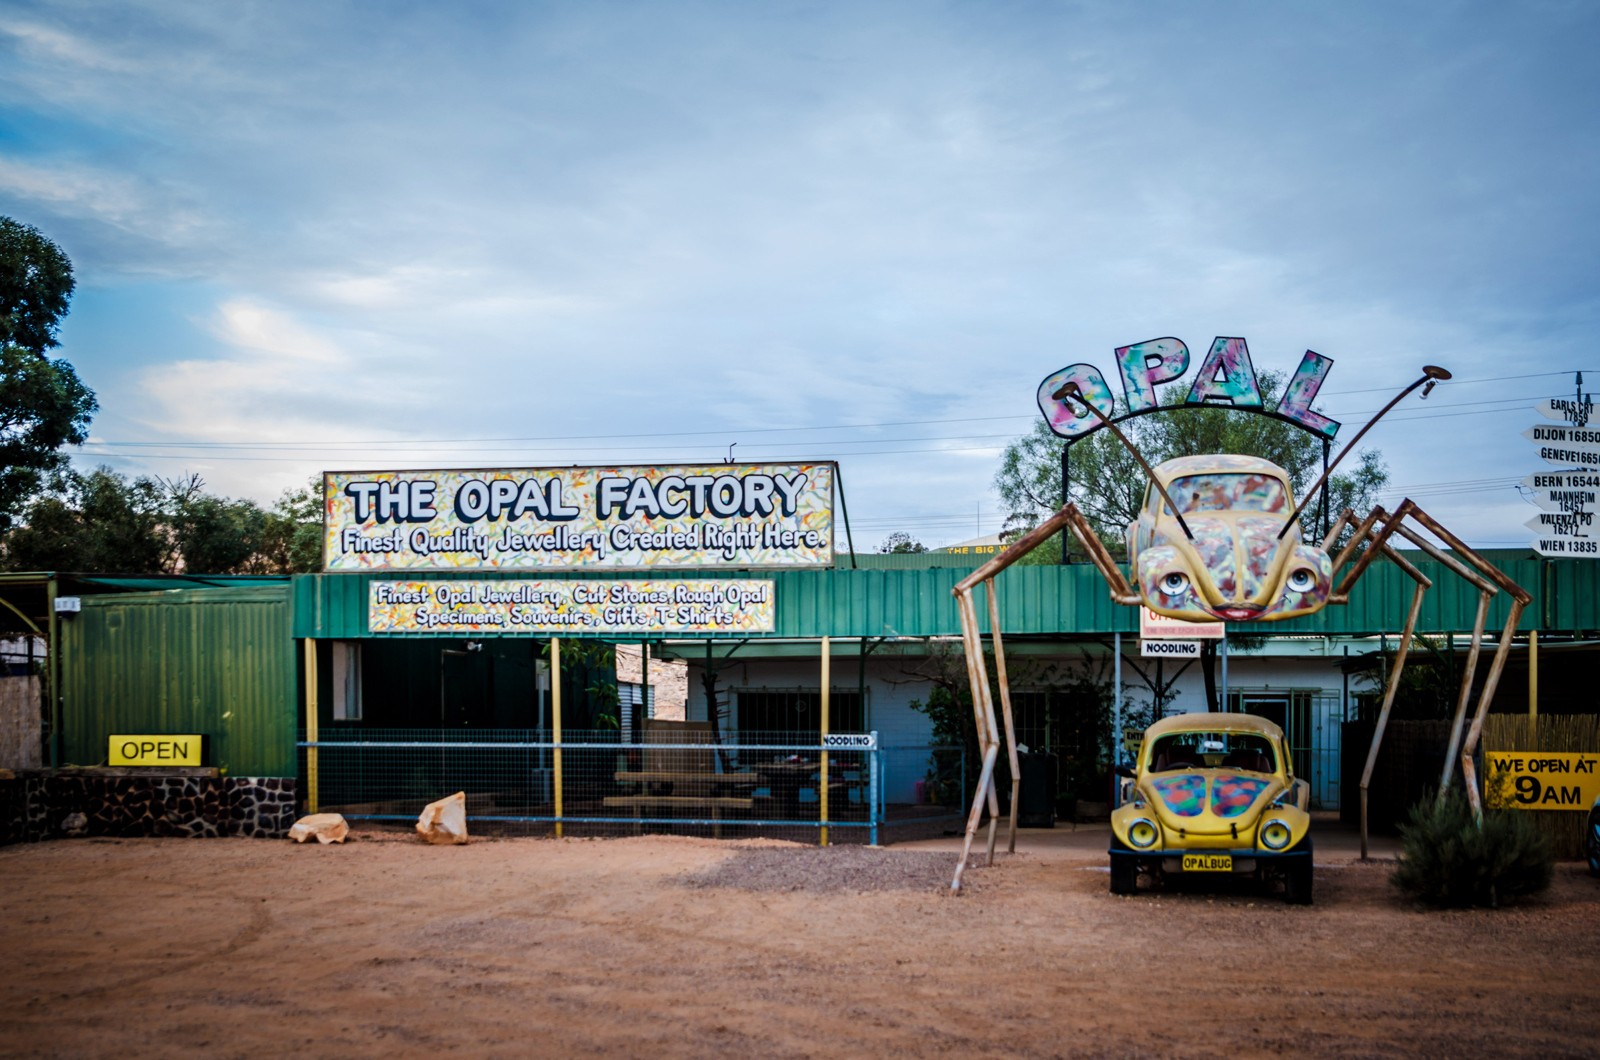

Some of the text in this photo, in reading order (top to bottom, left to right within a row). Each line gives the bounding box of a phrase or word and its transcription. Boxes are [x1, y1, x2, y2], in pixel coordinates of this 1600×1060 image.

[1036, 336, 1342, 440] OPAL
[1550, 399, 1594, 414] EARLS CRT
[1564, 410, 1589, 423] 17859
[1533, 428, 1600, 443] DIJON 16850
[1534, 475, 1600, 488] BERN 16544
[345, 473, 808, 524] THE OPAL FACTORY
[1550, 490, 1595, 503] MANNHEIM
[1559, 500, 1585, 513] 16457
[1540, 514, 1592, 526] VALENZA PO
[342, 522, 827, 561] Finest Quality Jewellery Created Right Here.
[1540, 540, 1597, 553] WIEN 13835
[947, 547, 969, 555] THE
[975, 545, 995, 554] BIG
[377, 585, 429, 604] Finest
[436, 585, 477, 609] Opal
[573, 585, 607, 604] Cut
[674, 584, 724, 611] Rough
[726, 584, 767, 611] Opal
[1146, 643, 1196, 653] NOODLING
[823, 736, 870, 746] NOODLING
[121, 741, 188, 760] OPEN
[1494, 758, 1597, 774] WE OPEN AT
[1184, 858, 1231, 869] OPALBUG
